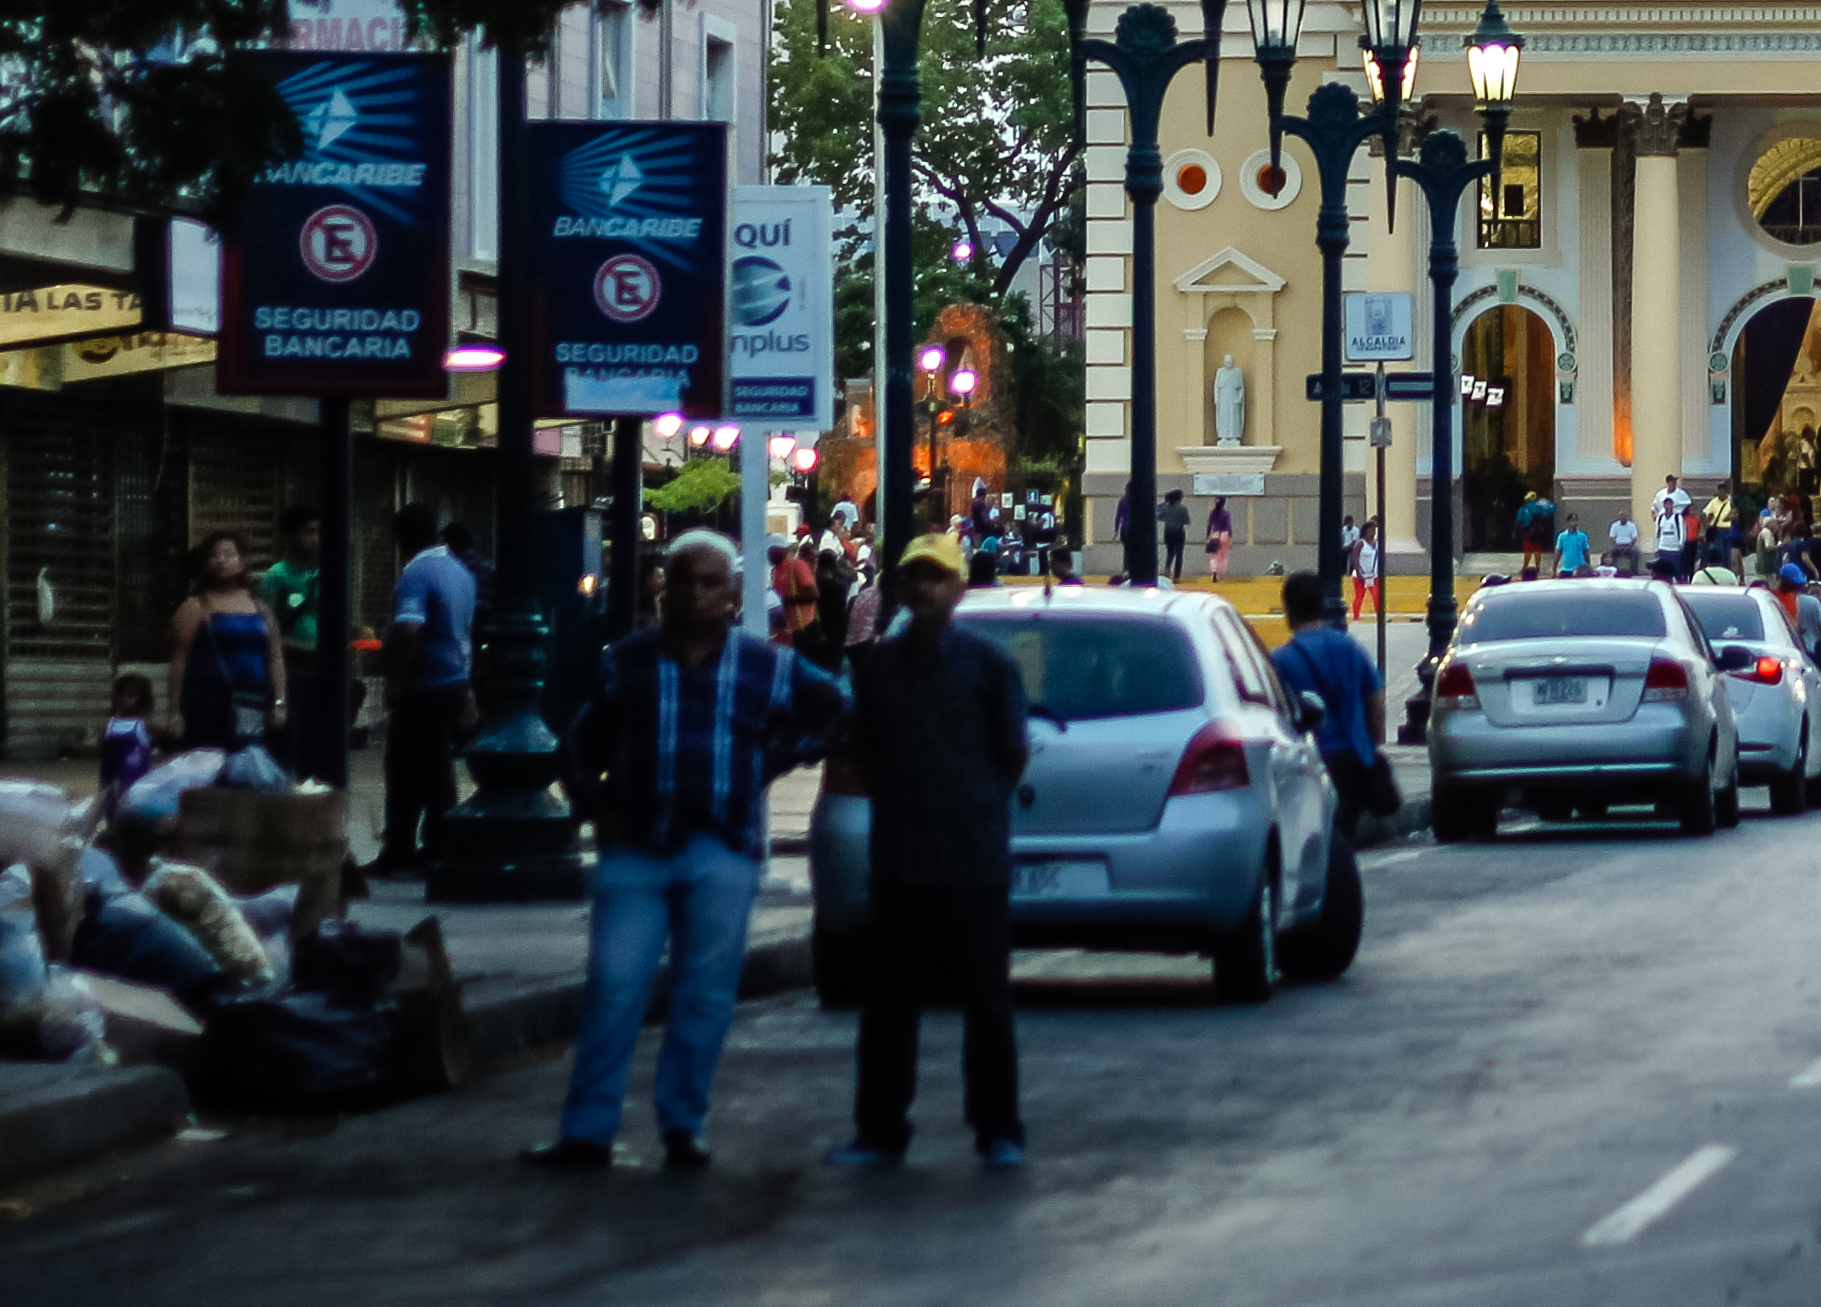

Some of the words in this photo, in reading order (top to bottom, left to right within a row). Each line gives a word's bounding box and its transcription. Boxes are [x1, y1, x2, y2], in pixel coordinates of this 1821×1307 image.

[254, 162, 427, 186] ANCARIBE
[553, 216, 702, 237] BANCARIBE
[734, 218, 791, 248] QUÍ
[46, 292, 102, 310] LAS
[110, 292, 142, 310] TA
[255, 306, 420, 331] SEGURIDAD
[264, 335, 411, 358] BANCARIA
[556, 343, 699, 363] SEGURIDAD
[731, 329, 810, 358] nplus
